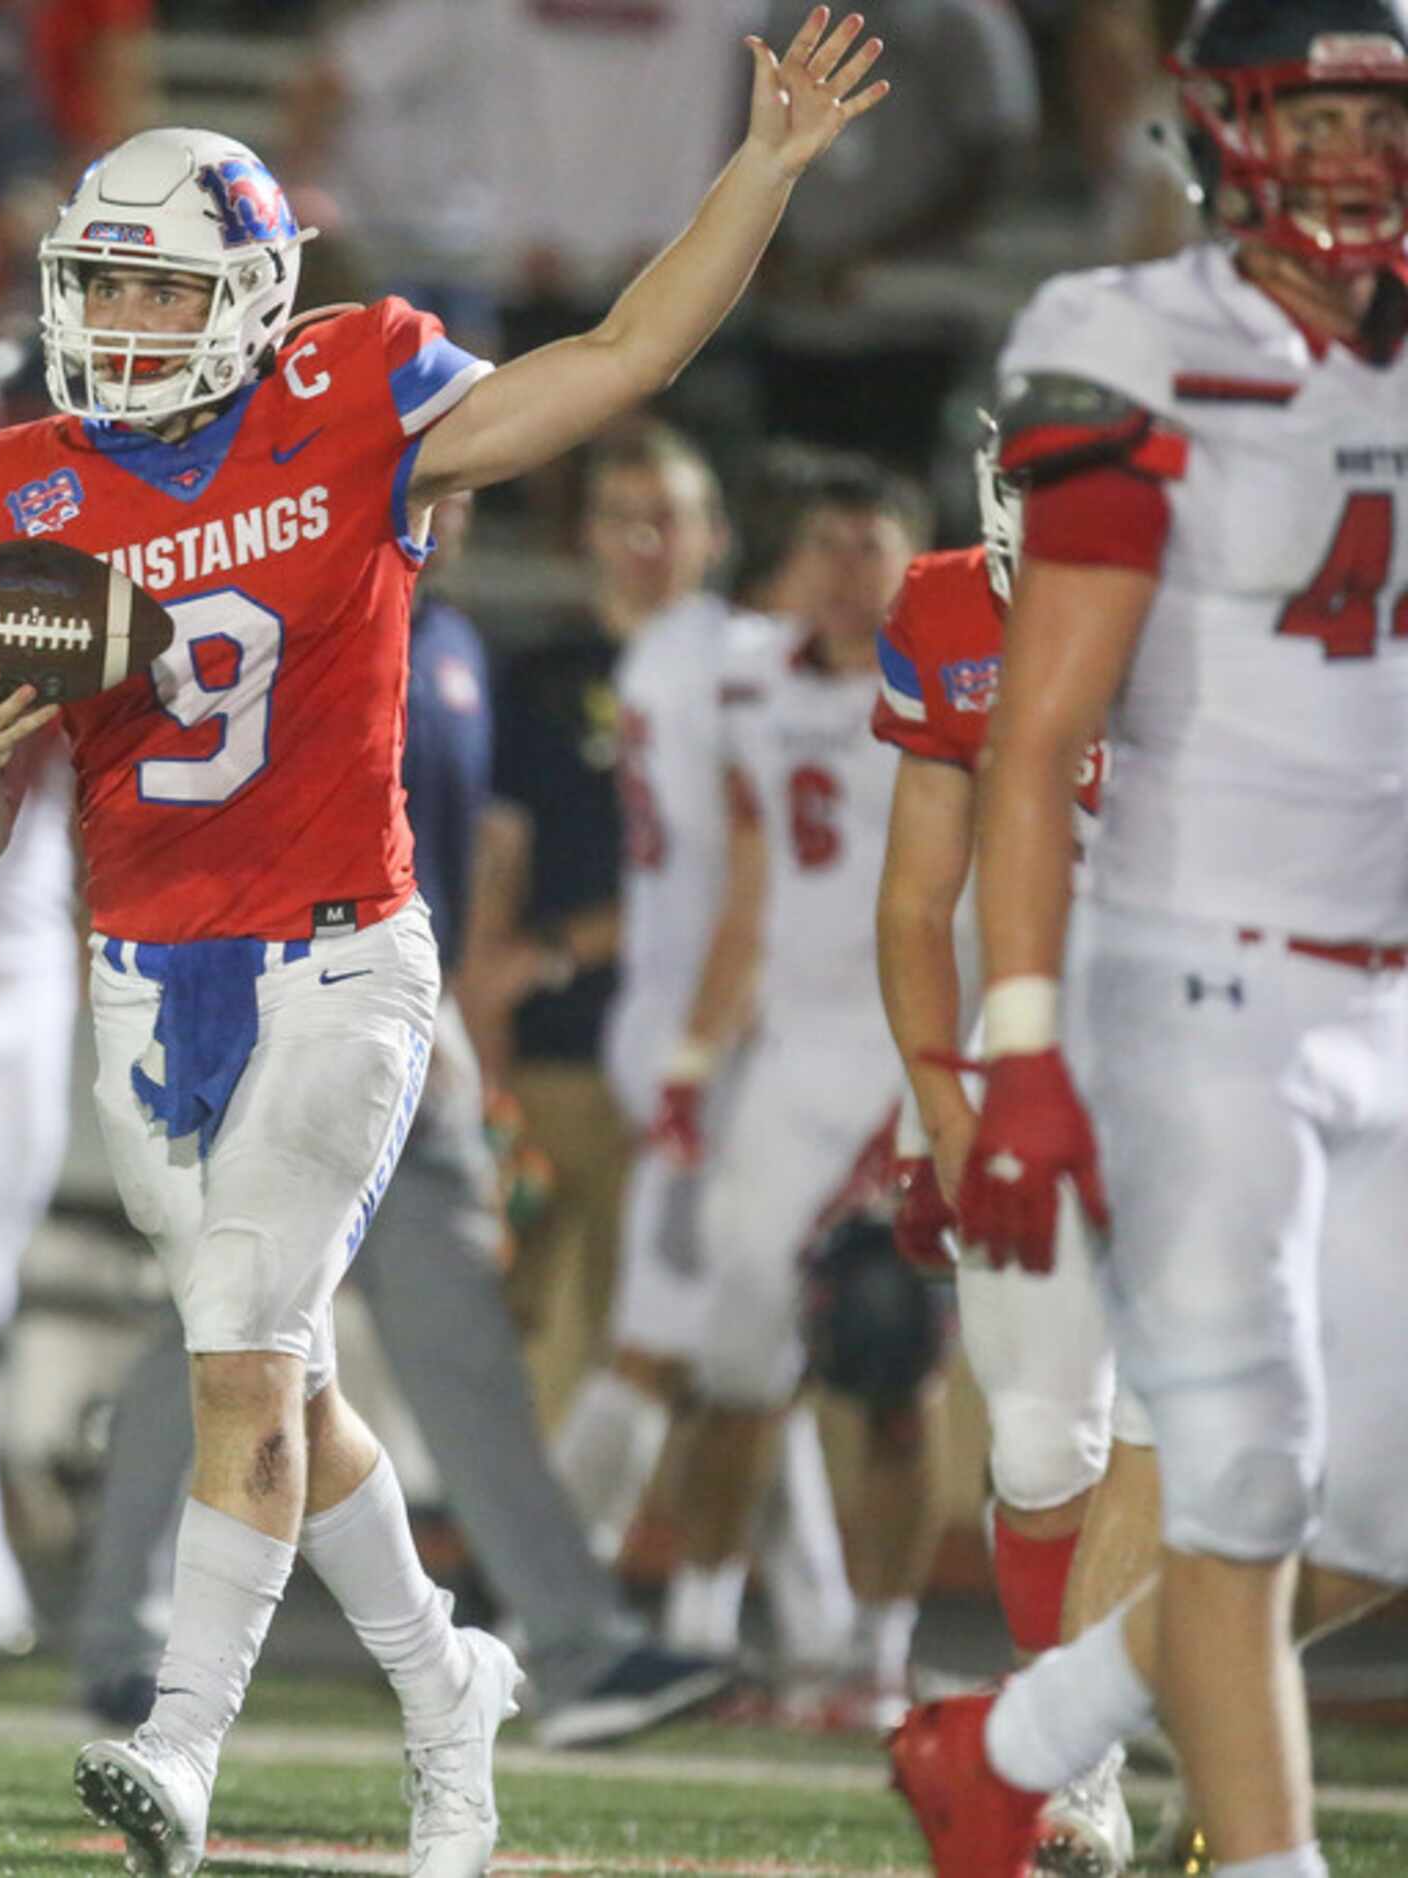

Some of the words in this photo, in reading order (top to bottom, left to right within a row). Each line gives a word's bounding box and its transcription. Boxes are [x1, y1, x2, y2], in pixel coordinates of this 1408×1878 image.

[283, 340, 332, 399] C
[134, 584, 285, 808] 9
[326, 906, 344, 921] M
